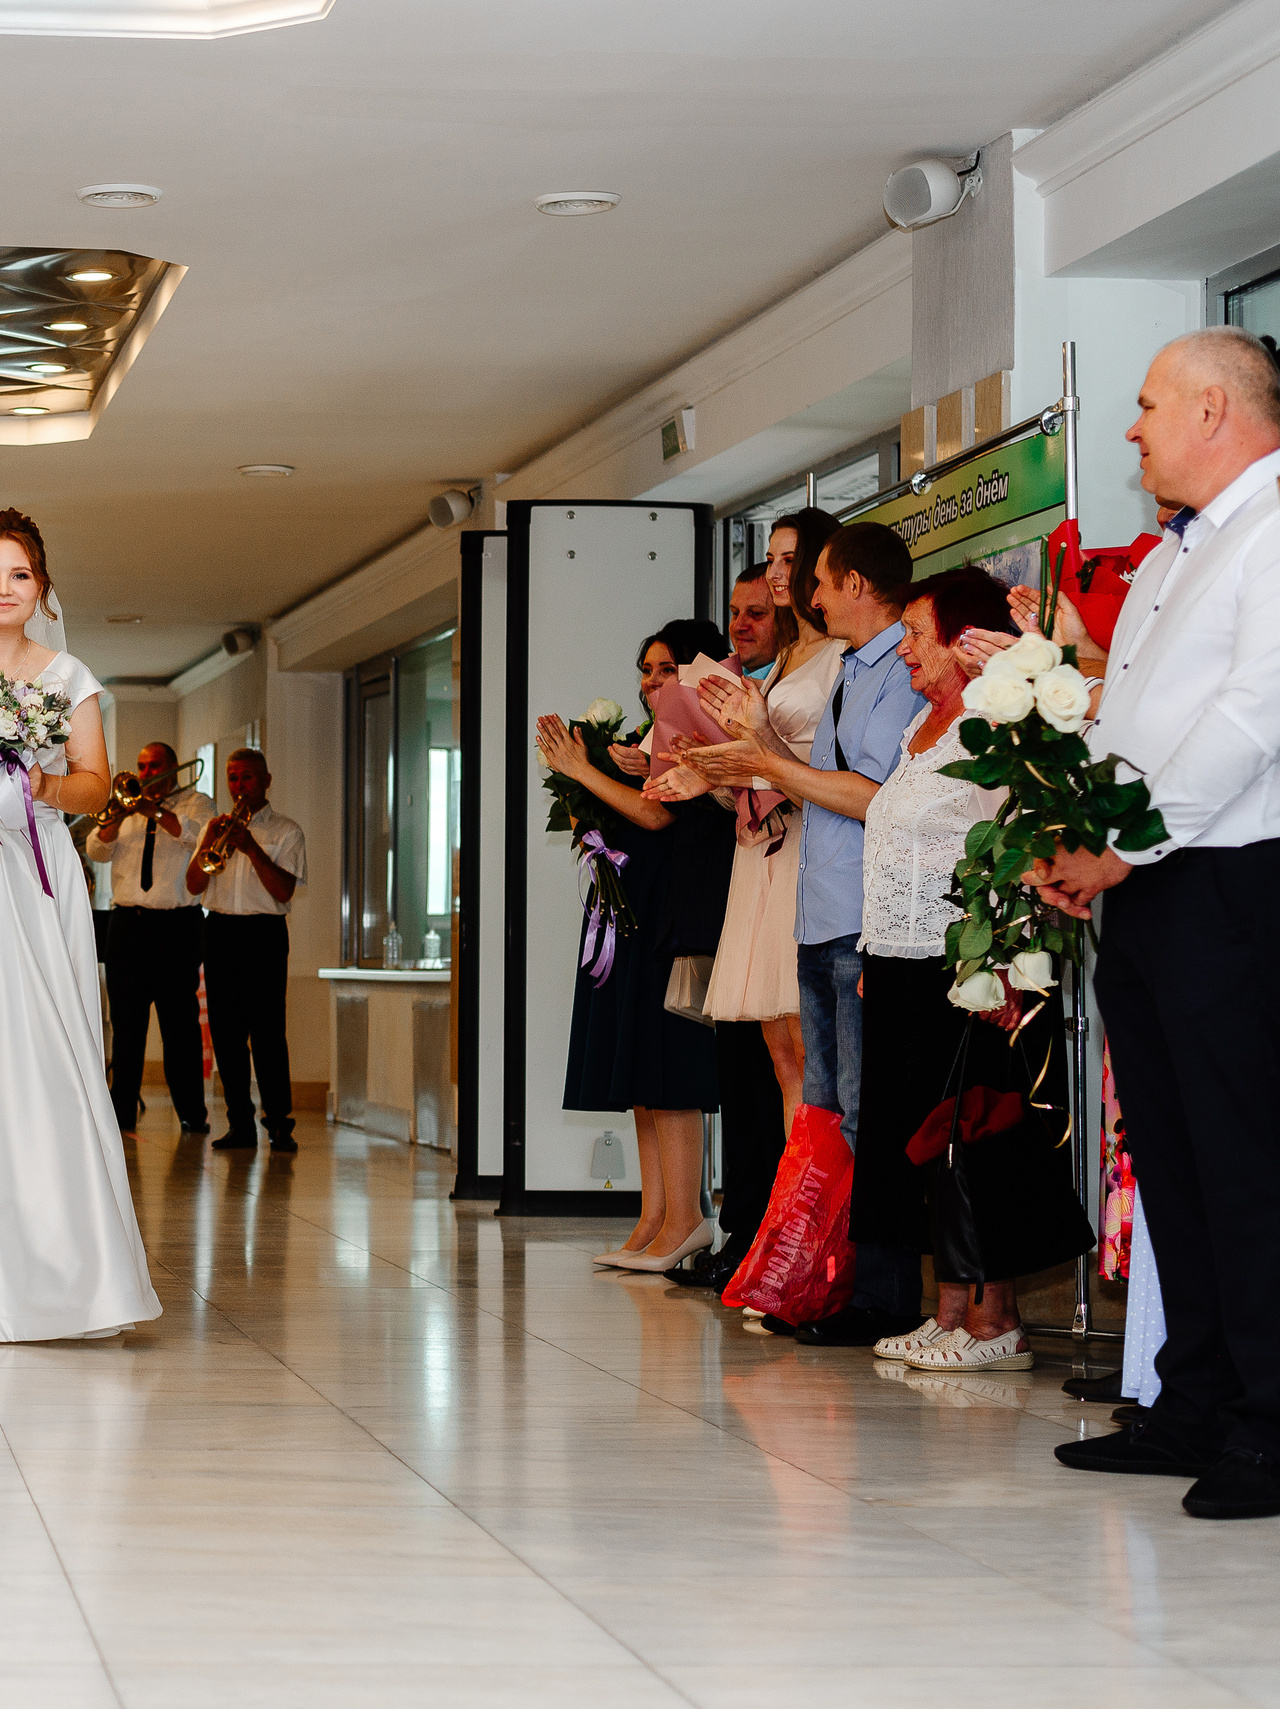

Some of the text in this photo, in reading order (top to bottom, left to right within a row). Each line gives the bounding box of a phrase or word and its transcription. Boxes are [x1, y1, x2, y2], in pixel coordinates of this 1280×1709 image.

[933, 494, 959, 529] день
[960, 487, 973, 517] за
[975, 469, 1009, 510] днём
[760, 1162, 829, 1290] РОДНЫ КУТ
